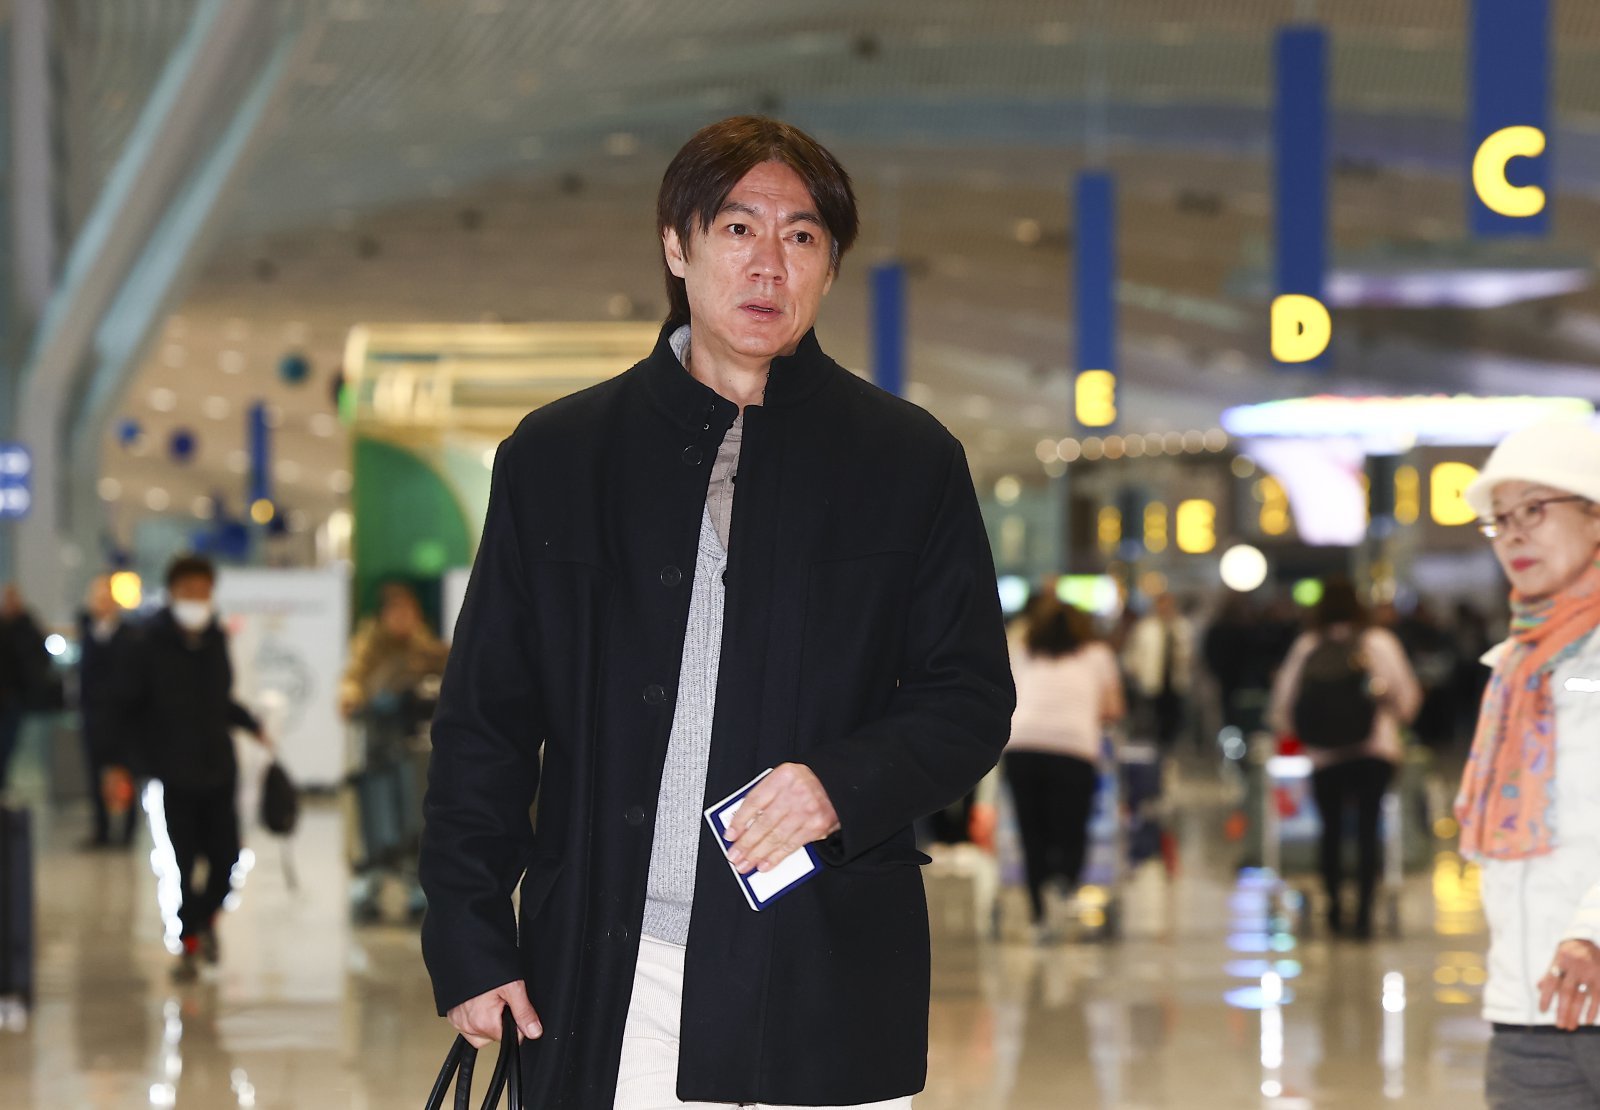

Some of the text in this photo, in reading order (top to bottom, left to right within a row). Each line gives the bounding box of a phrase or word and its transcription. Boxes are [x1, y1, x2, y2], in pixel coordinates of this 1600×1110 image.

[1472, 126, 1546, 217] C
[1271, 294, 1331, 363] D
[1075, 370, 1117, 427] E
